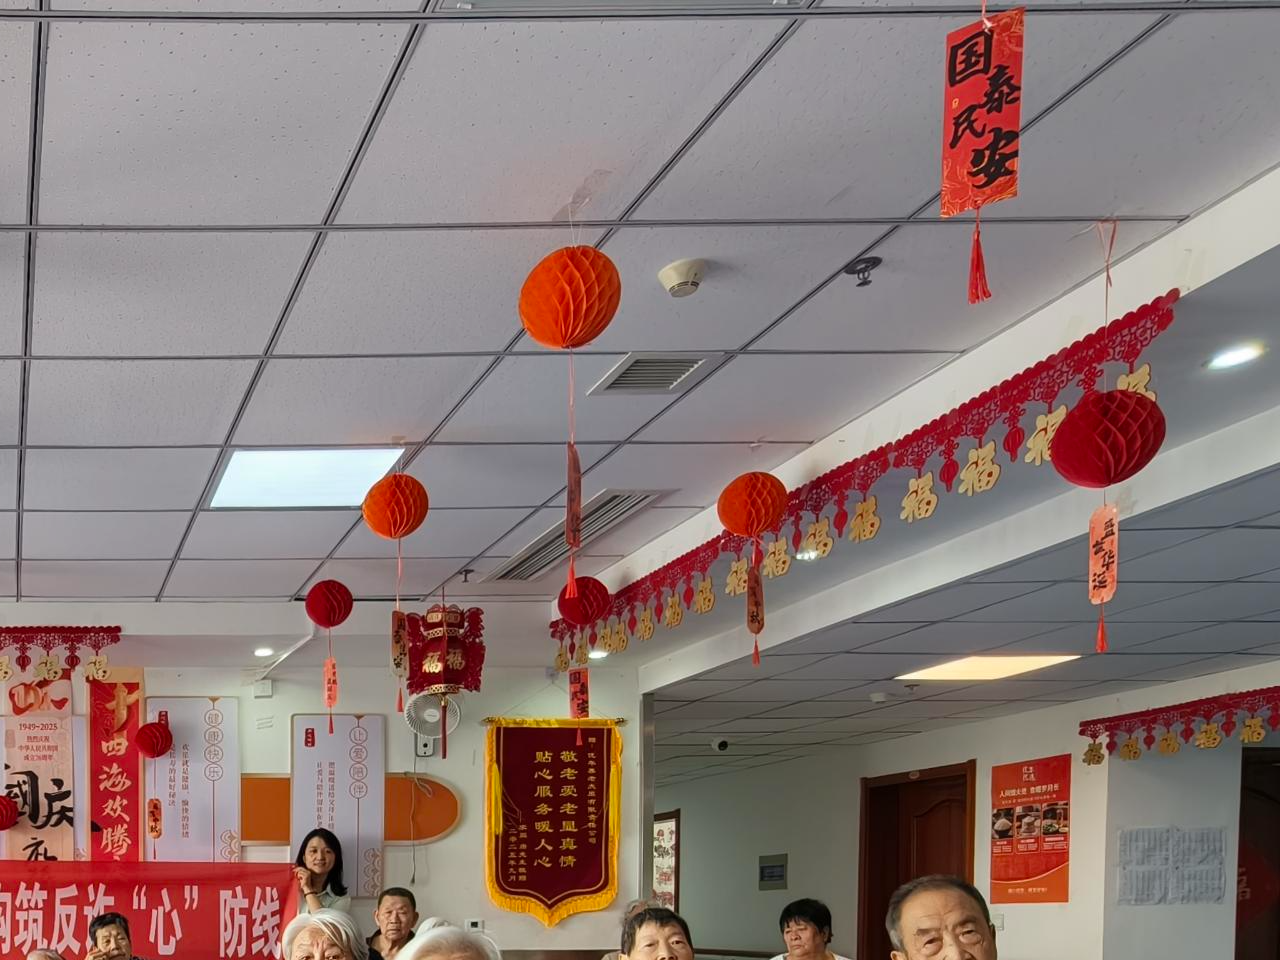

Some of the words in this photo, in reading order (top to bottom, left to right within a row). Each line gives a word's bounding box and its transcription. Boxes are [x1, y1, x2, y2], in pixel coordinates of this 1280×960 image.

[948, 30, 1020, 189] 国泰民安
[900, 472, 939, 522] 福
[958, 440, 1002, 496] 福
[849, 496, 881, 542] 福
[763, 537, 791, 578] 福
[694, 577, 716, 614] 福
[422, 651, 443, 674] 福
[446, 649, 466, 670] 福
[206, 711, 221, 779] 健康快乐
[351, 728, 366, 796] 让爱陪伴
[98, 738, 132, 861] 四海欢腾
[534, 750, 554, 868] 贴心服务暖人心
[559, 750, 579, 868] 敬老爱老显真情
